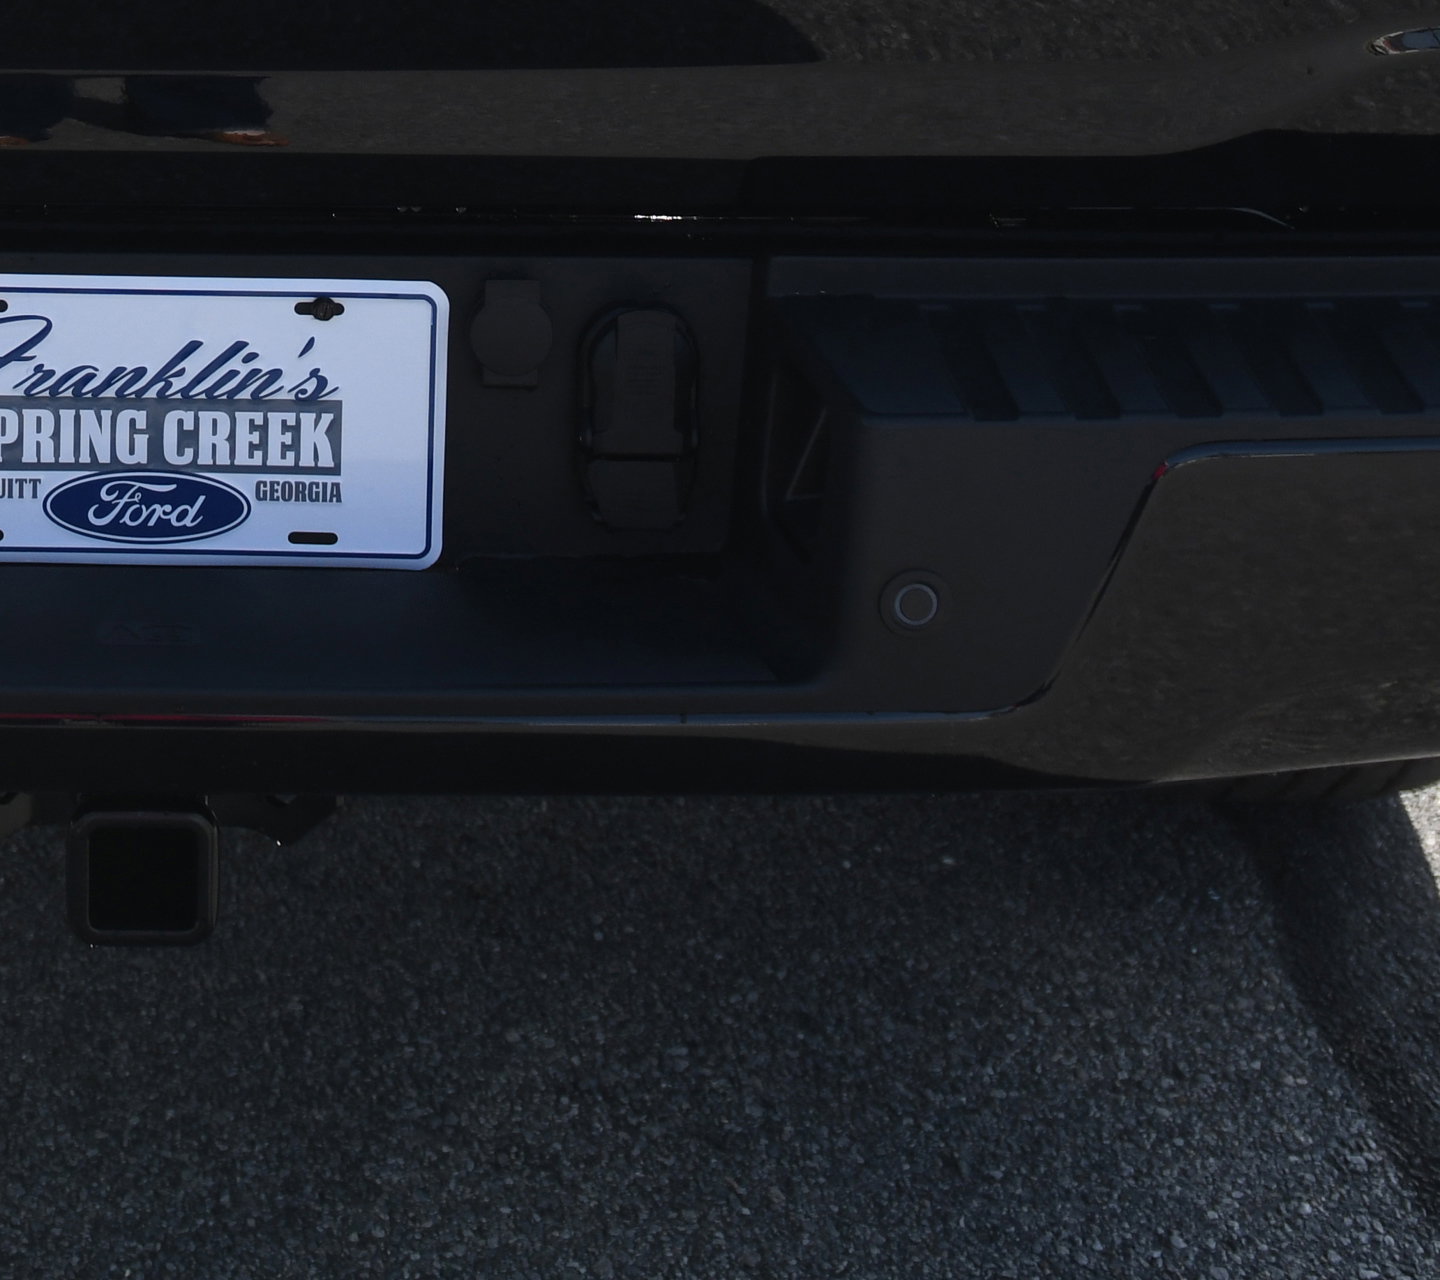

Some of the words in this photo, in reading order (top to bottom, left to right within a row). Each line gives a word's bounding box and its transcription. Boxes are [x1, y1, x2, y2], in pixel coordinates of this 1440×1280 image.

[162, 410, 336, 469] CREEK
[86, 481, 207, 530] Ford
[255, 480, 343, 504] GEORGIA
